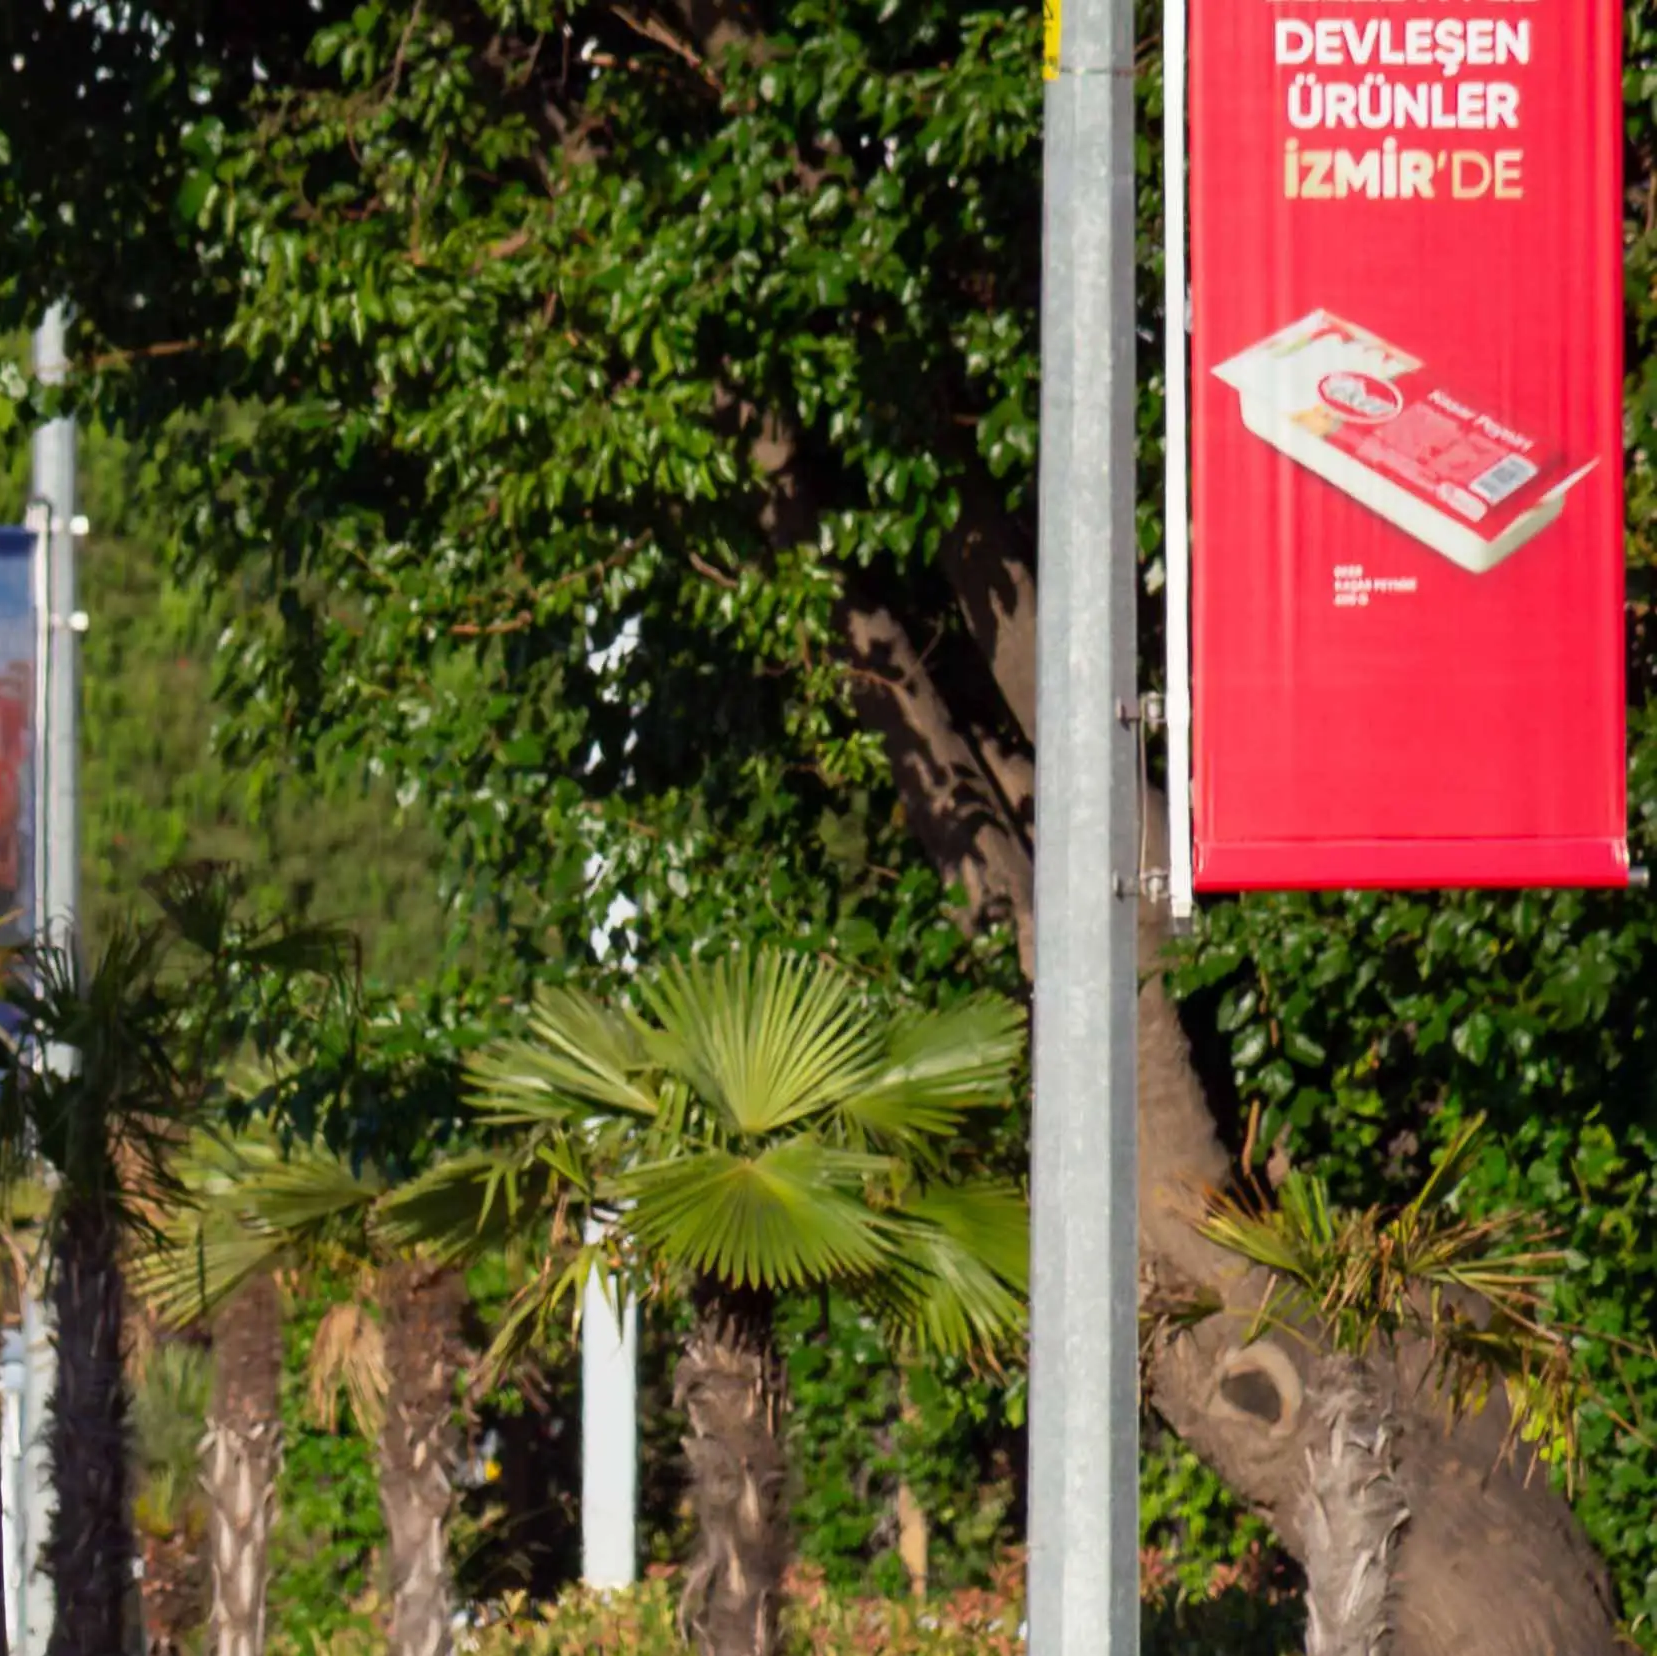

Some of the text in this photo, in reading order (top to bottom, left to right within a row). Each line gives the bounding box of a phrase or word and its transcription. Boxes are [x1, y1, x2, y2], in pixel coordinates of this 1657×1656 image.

[1275, 18, 1530, 77] DEVLEŞEN
[1287, 73, 1519, 129] ÜRÜNLER
[1284, 136, 1524, 199] İZMİR'DE
